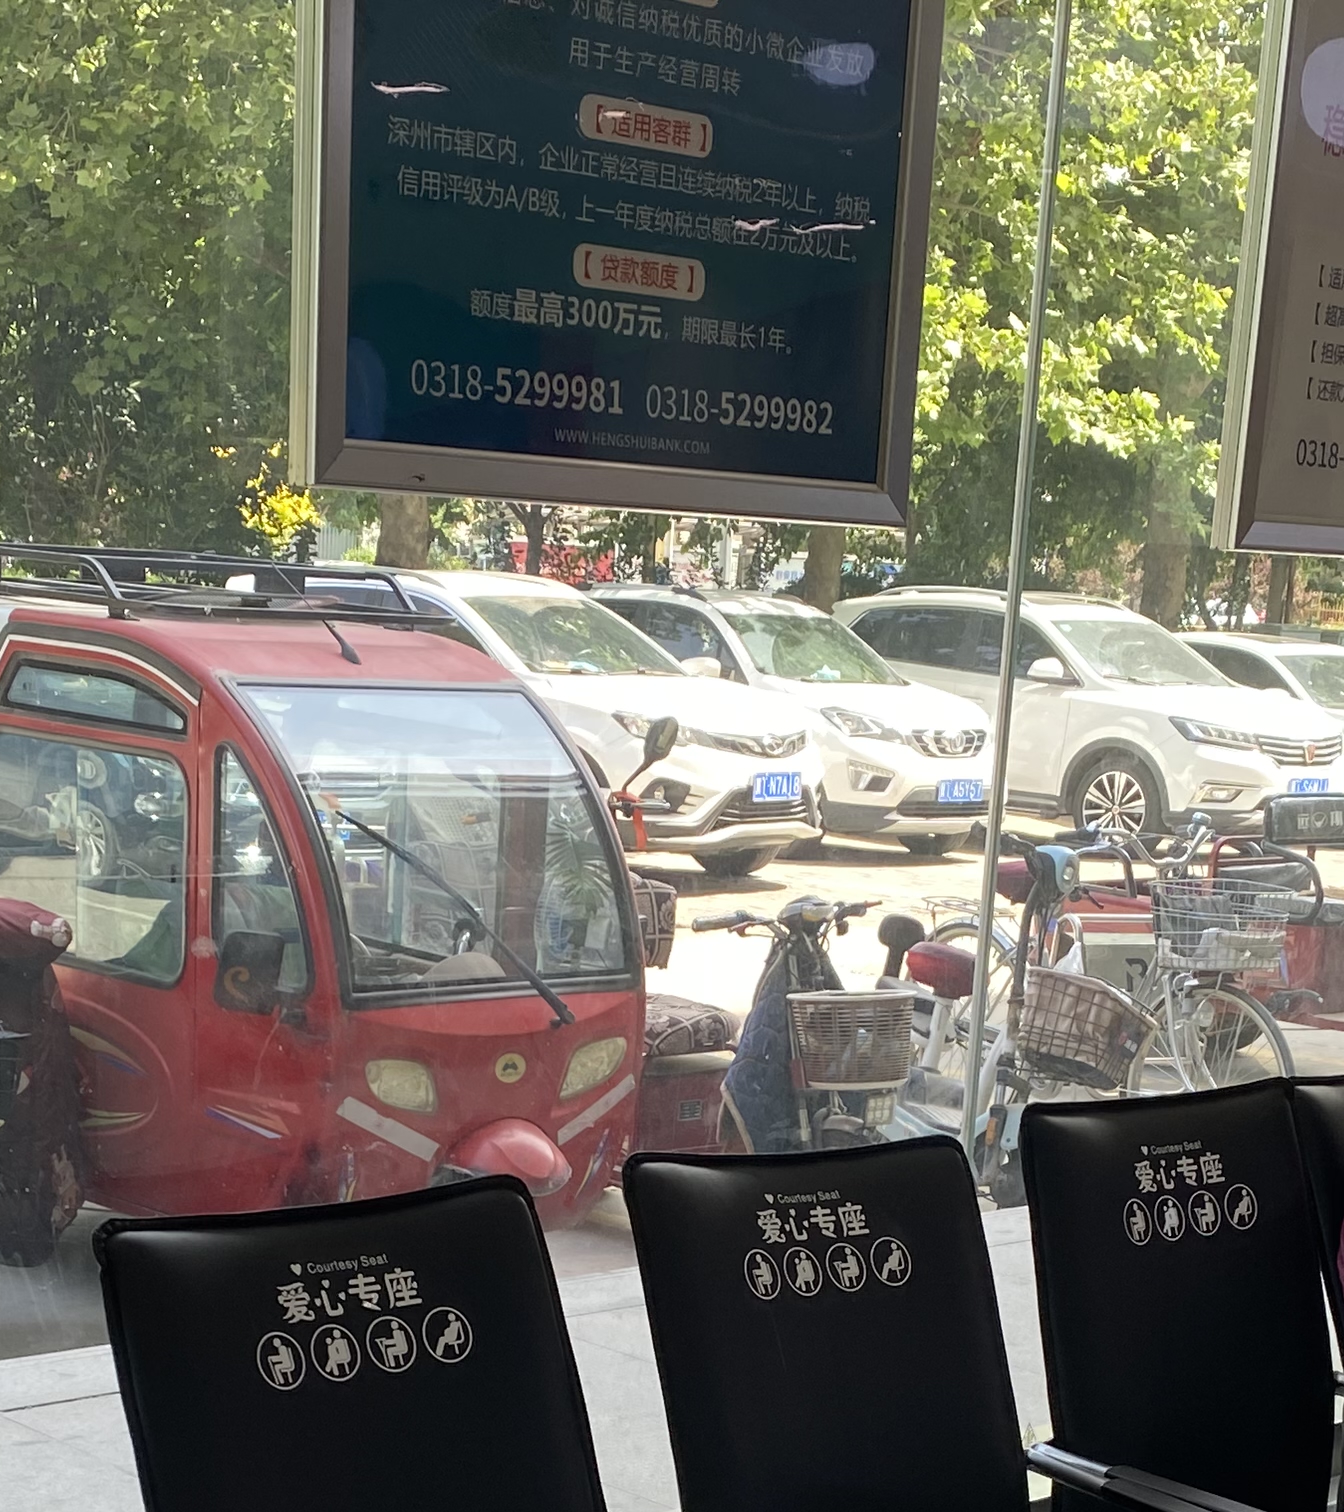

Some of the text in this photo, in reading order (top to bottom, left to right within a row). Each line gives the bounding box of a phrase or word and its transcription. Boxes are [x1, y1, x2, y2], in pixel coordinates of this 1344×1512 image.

[568, 37, 742, 97] 用于生产经营周转
[411, 358, 834, 436] 0318-5299981 0318-5299982
[555, 428, 710, 455] WWW.HENGSHUIBANK.COM
[1134, 1152, 1226, 1194] 爱心专座
[776, 1189, 841, 1205] Courtesy Seat
[756, 1202, 870, 1244] 爱心专座
[306, 1253, 389, 1276] Courtesy Seat
[276, 1267, 423, 1323] 爱心专座
